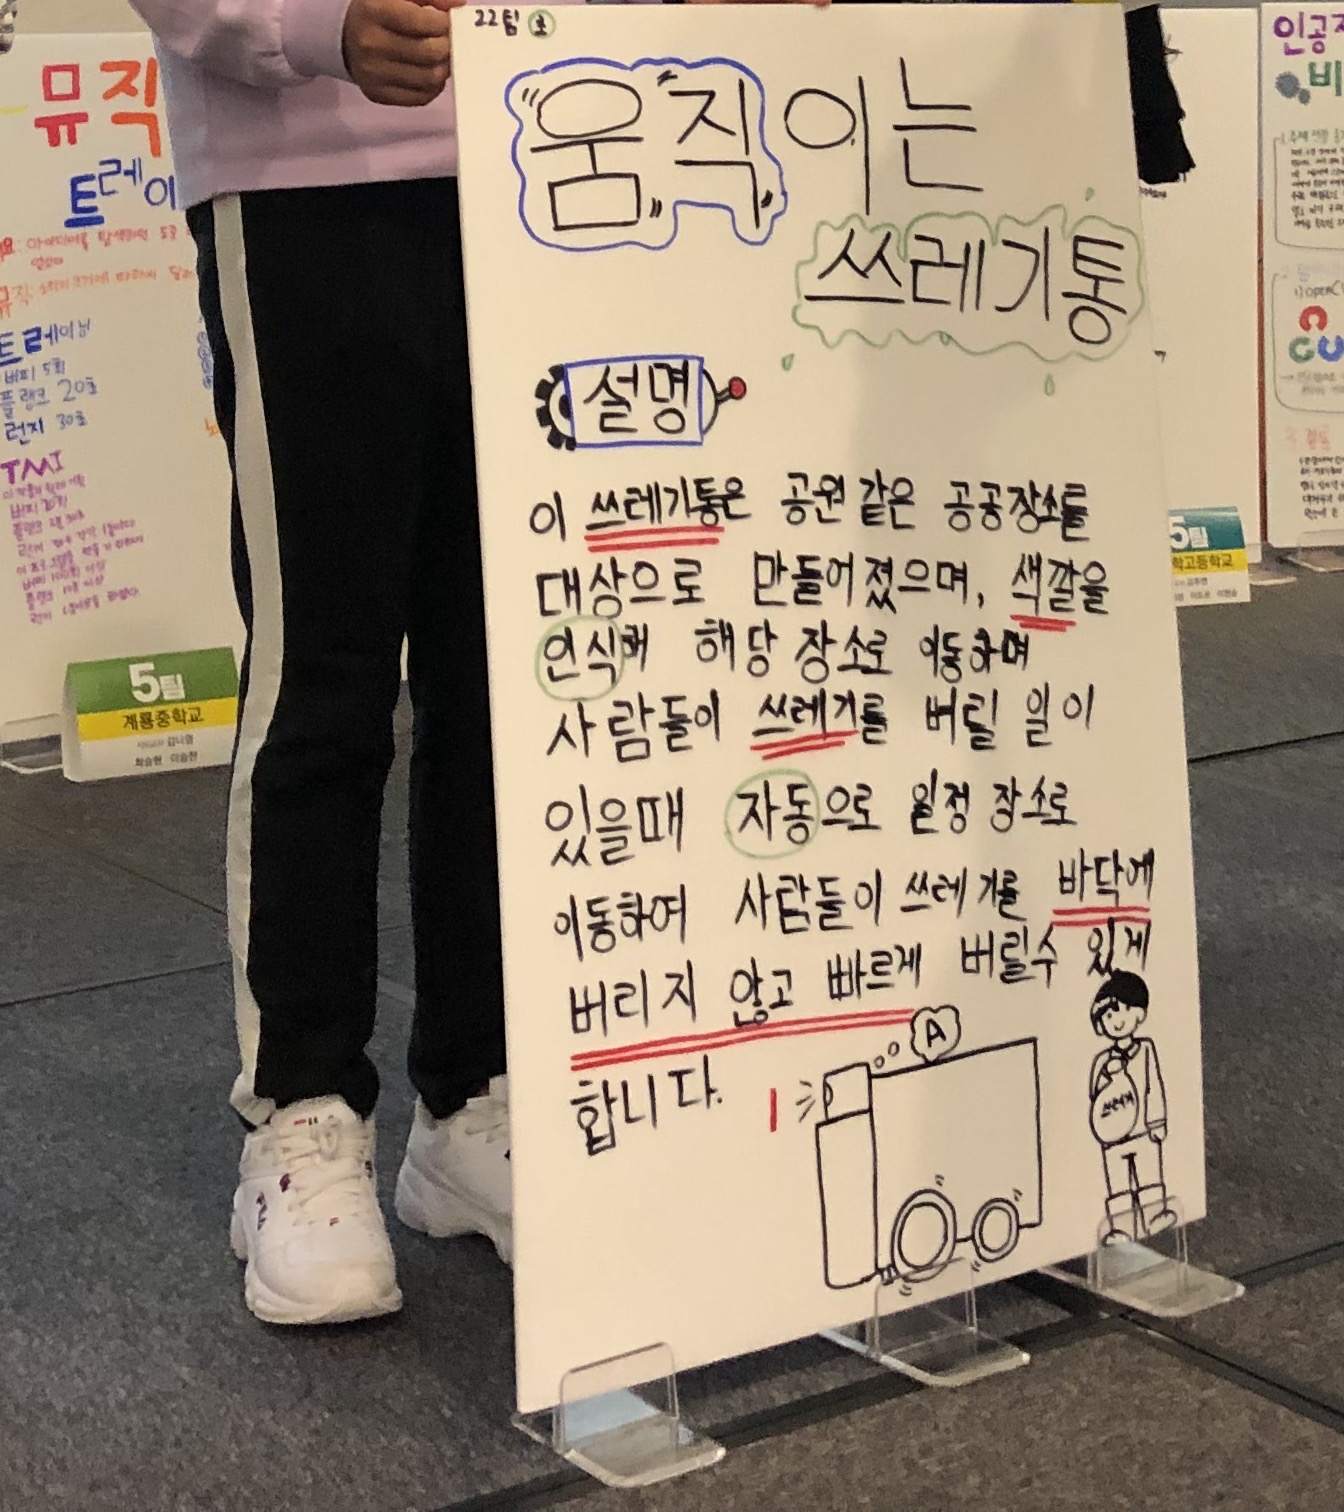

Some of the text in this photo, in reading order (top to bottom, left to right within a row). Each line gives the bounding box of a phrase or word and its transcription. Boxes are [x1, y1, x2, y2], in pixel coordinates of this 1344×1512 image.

[474, 8, 520, 37] 22팀
[34, 57, 162, 159] 뮤직
[530, 56, 985, 231] 움직이는
[803, 225, 1130, 344] 쓰레기통
[582, 359, 691, 434] 설명
[0, 449, 64, 485] TMI
[530, 493, 565, 540] 이
[781, 473, 845, 525] 공원
[859, 469, 914, 530] 같은
[537, 557, 702, 619] 대상으로
[695, 619, 777, 677] 해당
[795, 620, 892, 683] 장소로
[548, 689, 719, 762] 사람들이
[926, 687, 998, 750] 버릴
[737, 780, 880, 844] 자동으로
[554, 884, 688, 963] 이동하여
[736, 869, 881, 934] 사람들이
[569, 960, 697, 1037] 버리지
[828, 943, 921, 1001] 빠르게
[923, 1017, 947, 1048] A
[571, 1055, 722, 1156] 합니다.
